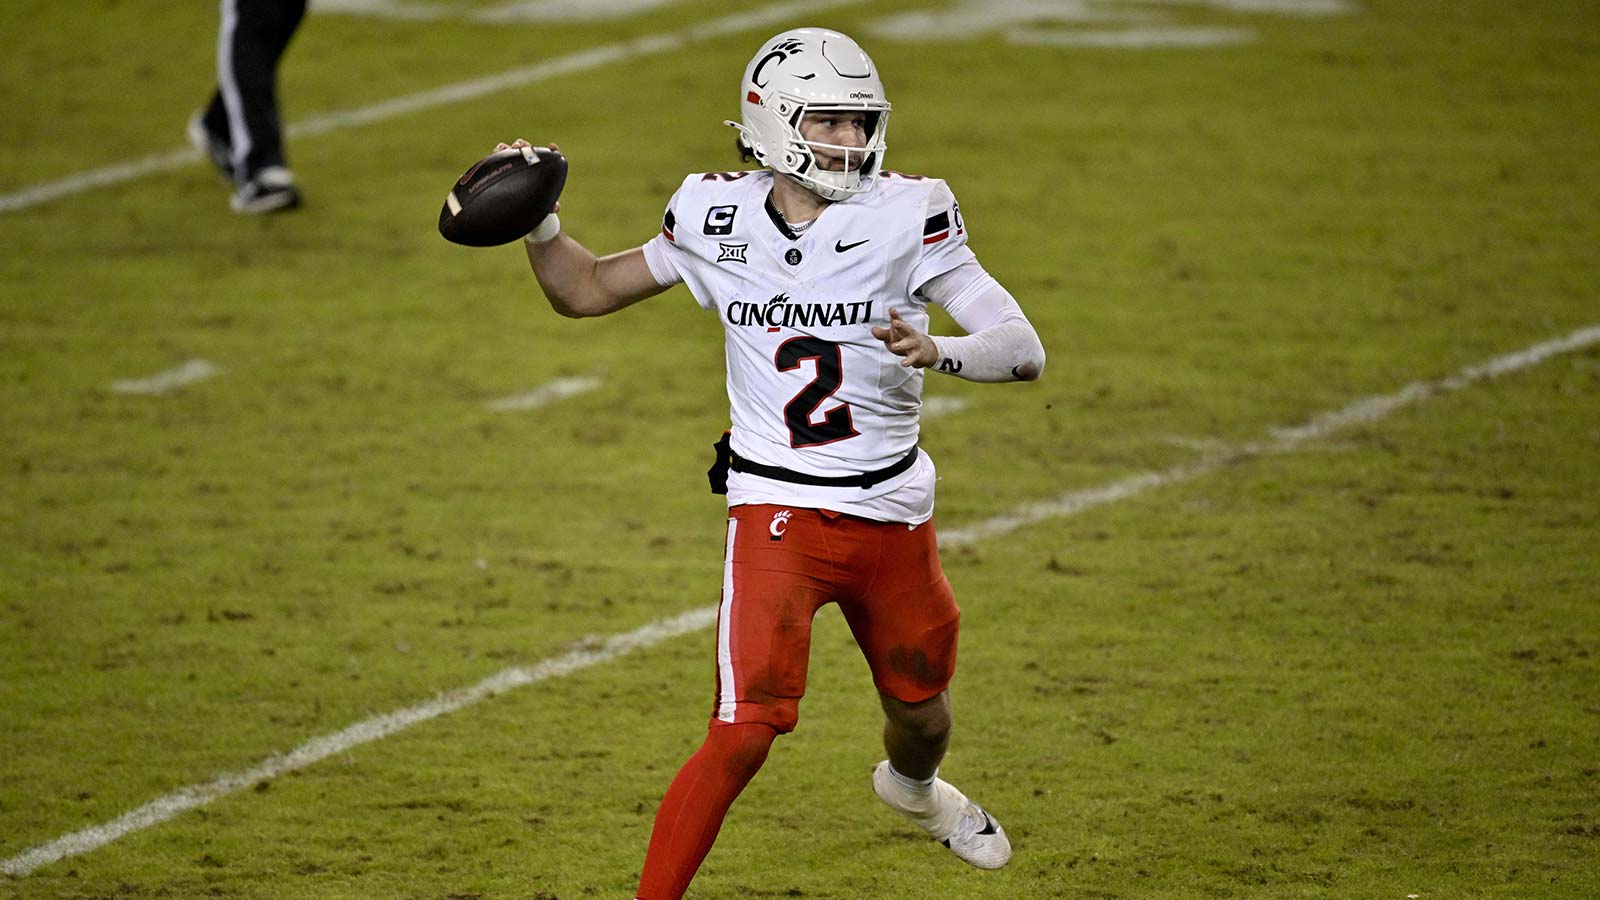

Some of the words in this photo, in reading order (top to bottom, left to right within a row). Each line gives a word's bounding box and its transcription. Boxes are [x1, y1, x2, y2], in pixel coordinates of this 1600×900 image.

[708, 206, 735, 227] C
[727, 293, 874, 328] CINCINNATI
[939, 356, 963, 373] 2
[774, 335, 862, 449] 2
